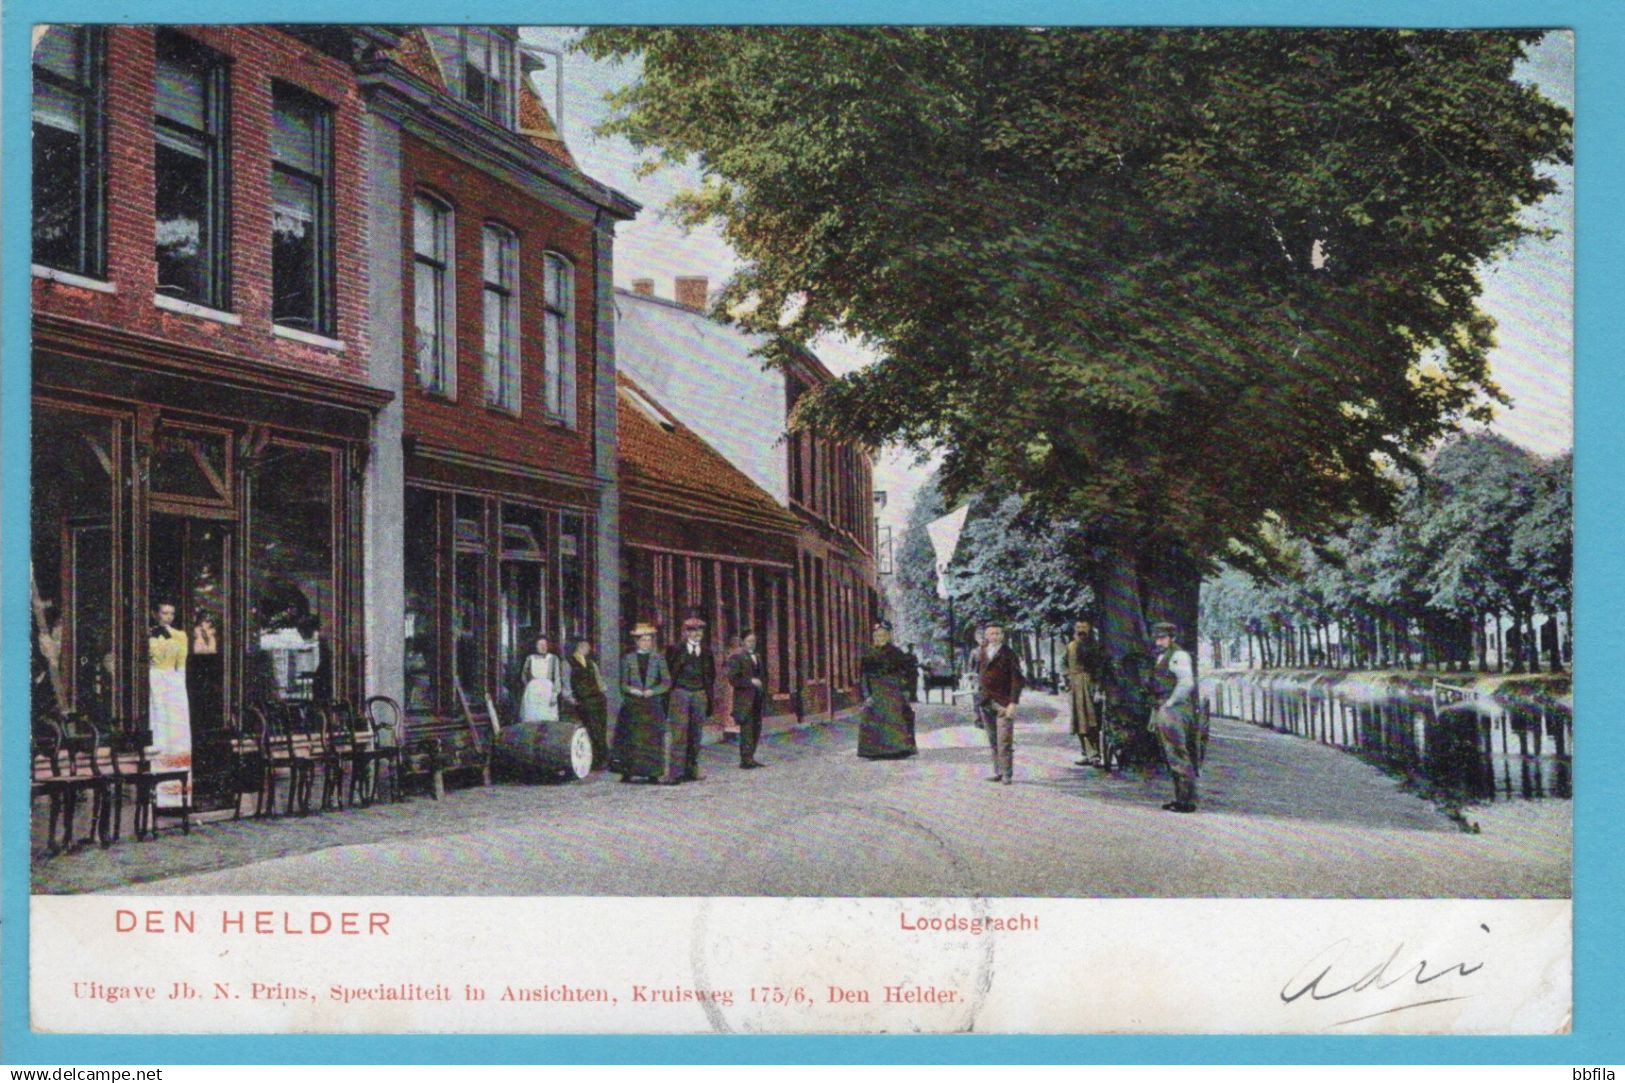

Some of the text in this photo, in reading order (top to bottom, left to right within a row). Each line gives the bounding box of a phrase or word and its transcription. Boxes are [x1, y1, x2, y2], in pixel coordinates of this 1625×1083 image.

[115, 909, 391, 936] DEN HELDER
[899, 912, 1040, 935] Loodsgracht
[73, 982, 156, 1003] Uitgave
[213, 982, 240, 1000] N.
[251, 982, 316, 1004] Prins,
[330, 983, 452, 1004] Specialiteit
[464, 983, 486, 1002] in
[500, 984, 619, 1006] Ansichten,
[631, 985, 734, 1006] Kruisweg
[827, 986, 870, 1004] Den
[884, 986, 966, 1005] Helder.
